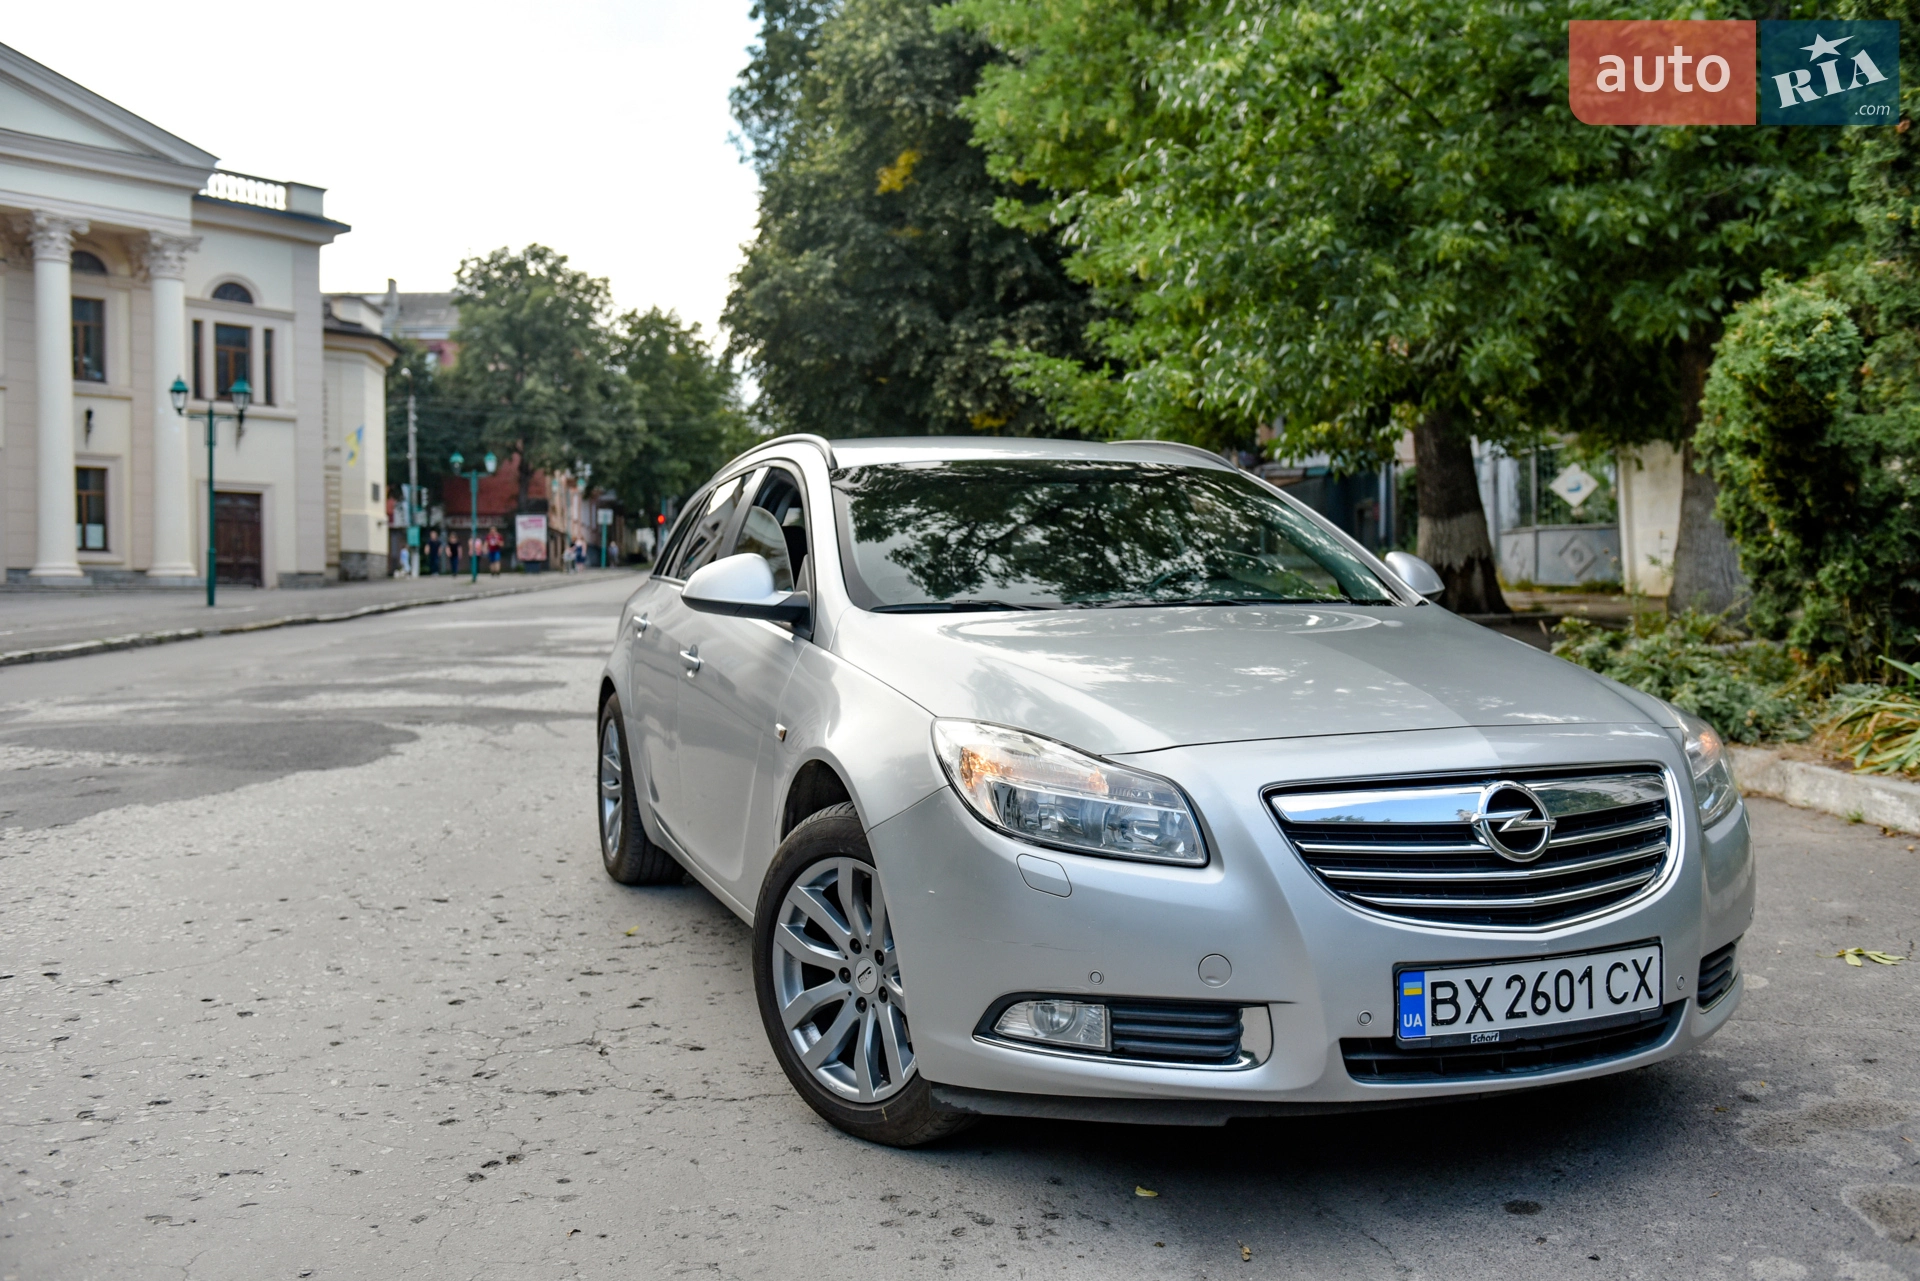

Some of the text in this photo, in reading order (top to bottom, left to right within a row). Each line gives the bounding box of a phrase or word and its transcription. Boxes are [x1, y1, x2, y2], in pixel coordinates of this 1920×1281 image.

[1430, 956, 1654, 1027] BX 2601 CX
[1403, 1013, 1423, 1028] UA
[1472, 1032, 1499, 1043] Scharf
